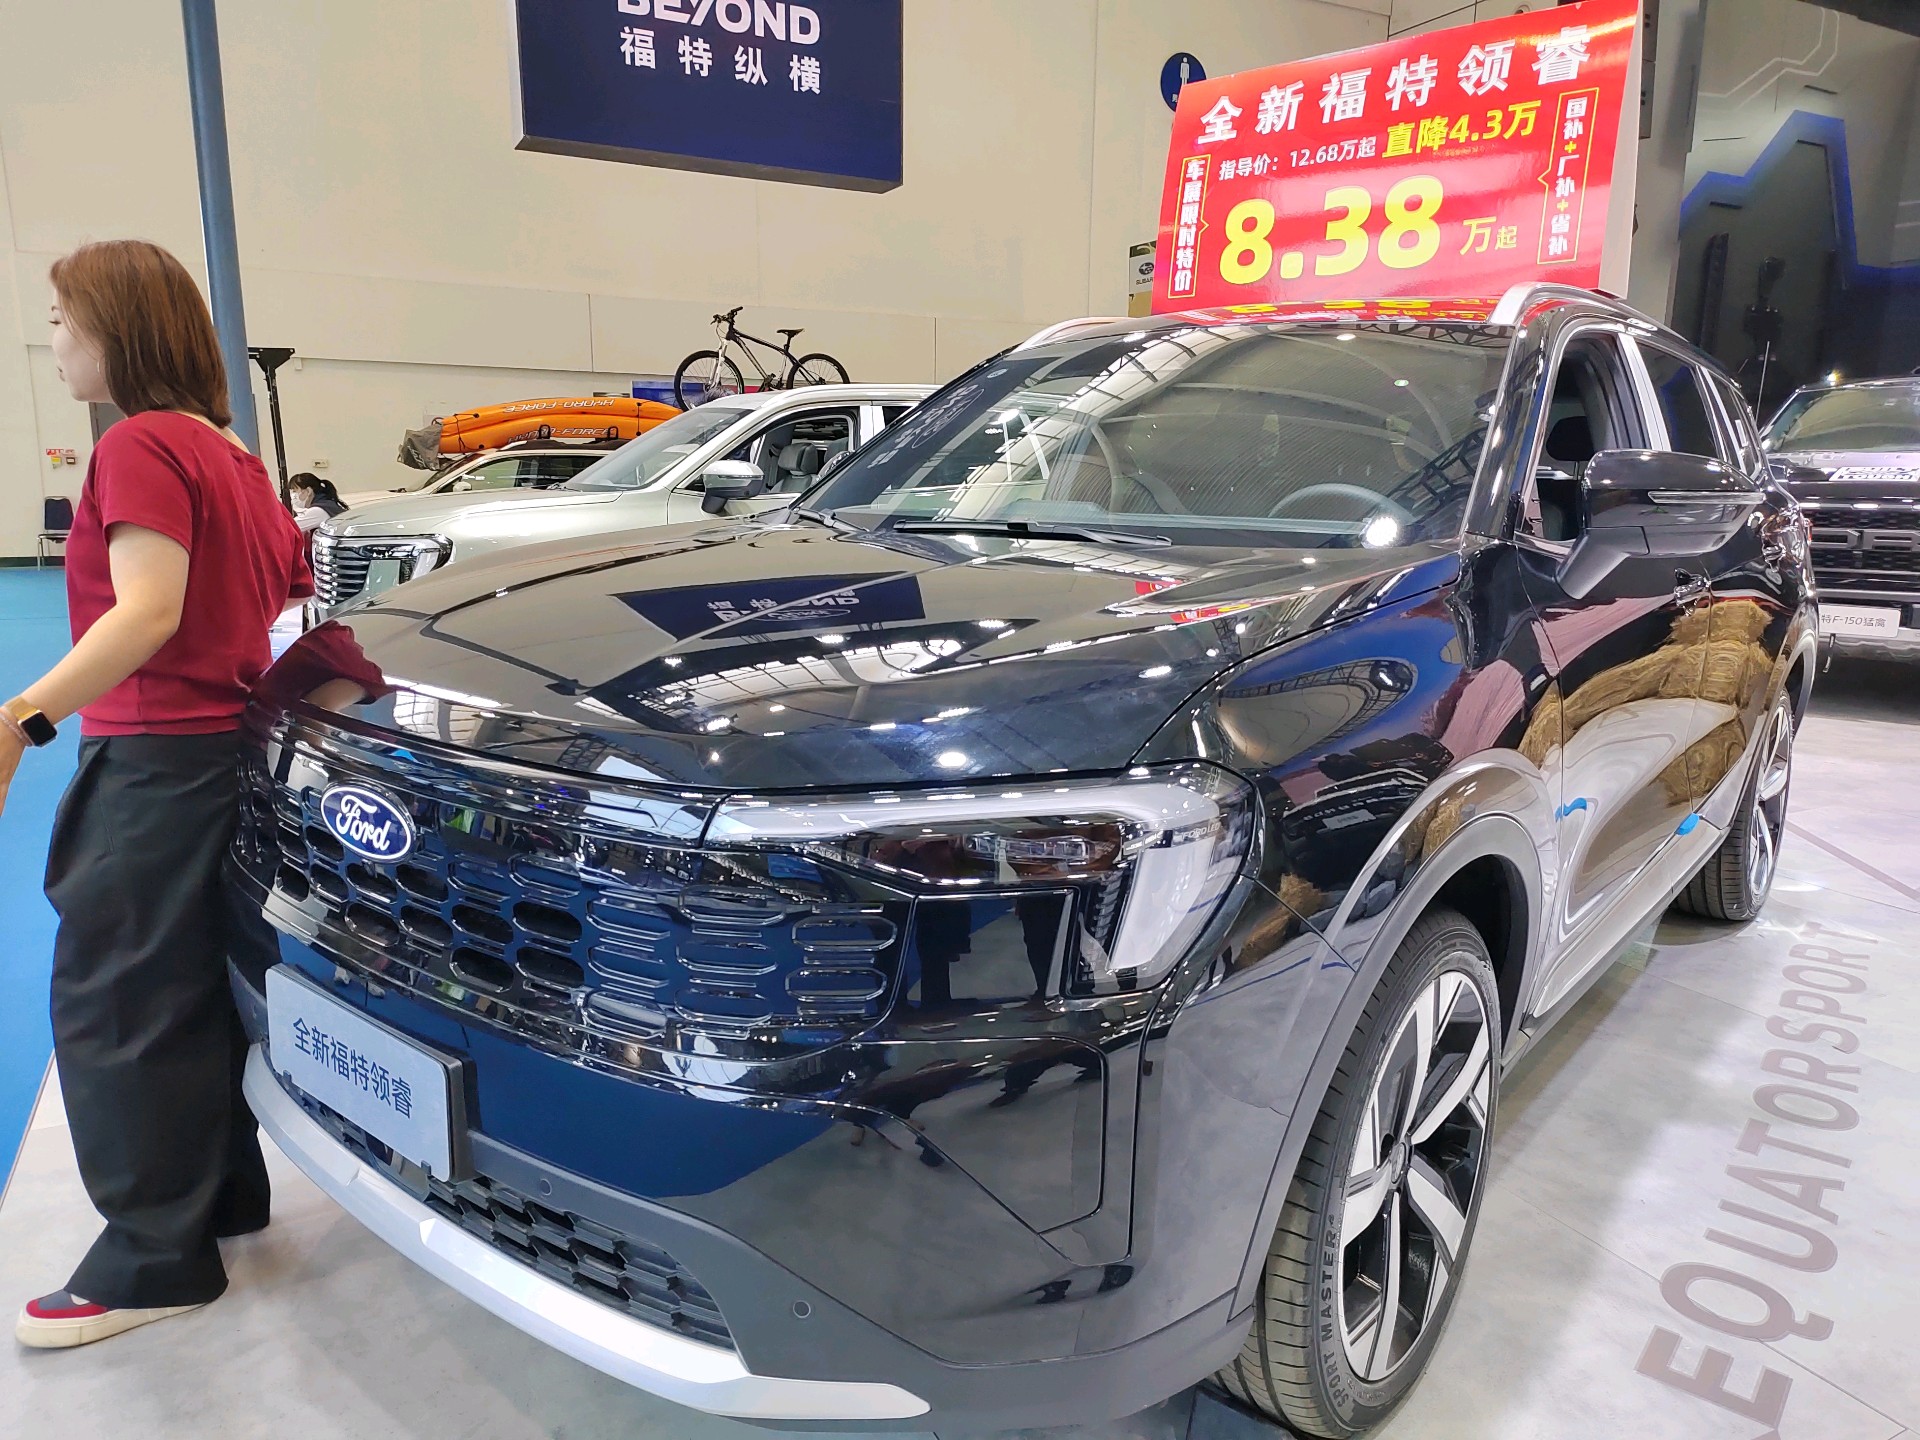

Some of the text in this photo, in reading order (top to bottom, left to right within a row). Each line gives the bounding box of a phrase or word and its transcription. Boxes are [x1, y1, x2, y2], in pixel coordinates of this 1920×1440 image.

[620, 26, 820, 94] 福特纵横
[1198, 26, 1591, 145] 全新福特领睿
[1382, 100, 1542, 158] 直降4.3万
[1548, 97, 1588, 256] 国补+厂补+省补
[1174, 160, 1206, 292] 车展限时特价
[1820, 613, 1887, 629] 特F-150猛禽
[335, 794, 391, 851] Ford
[293, 1018, 413, 1119] 全新福特领睿
[1321, 1229, 1337, 1344] MASTER
[1323, 1350, 1349, 1408] SPORT
